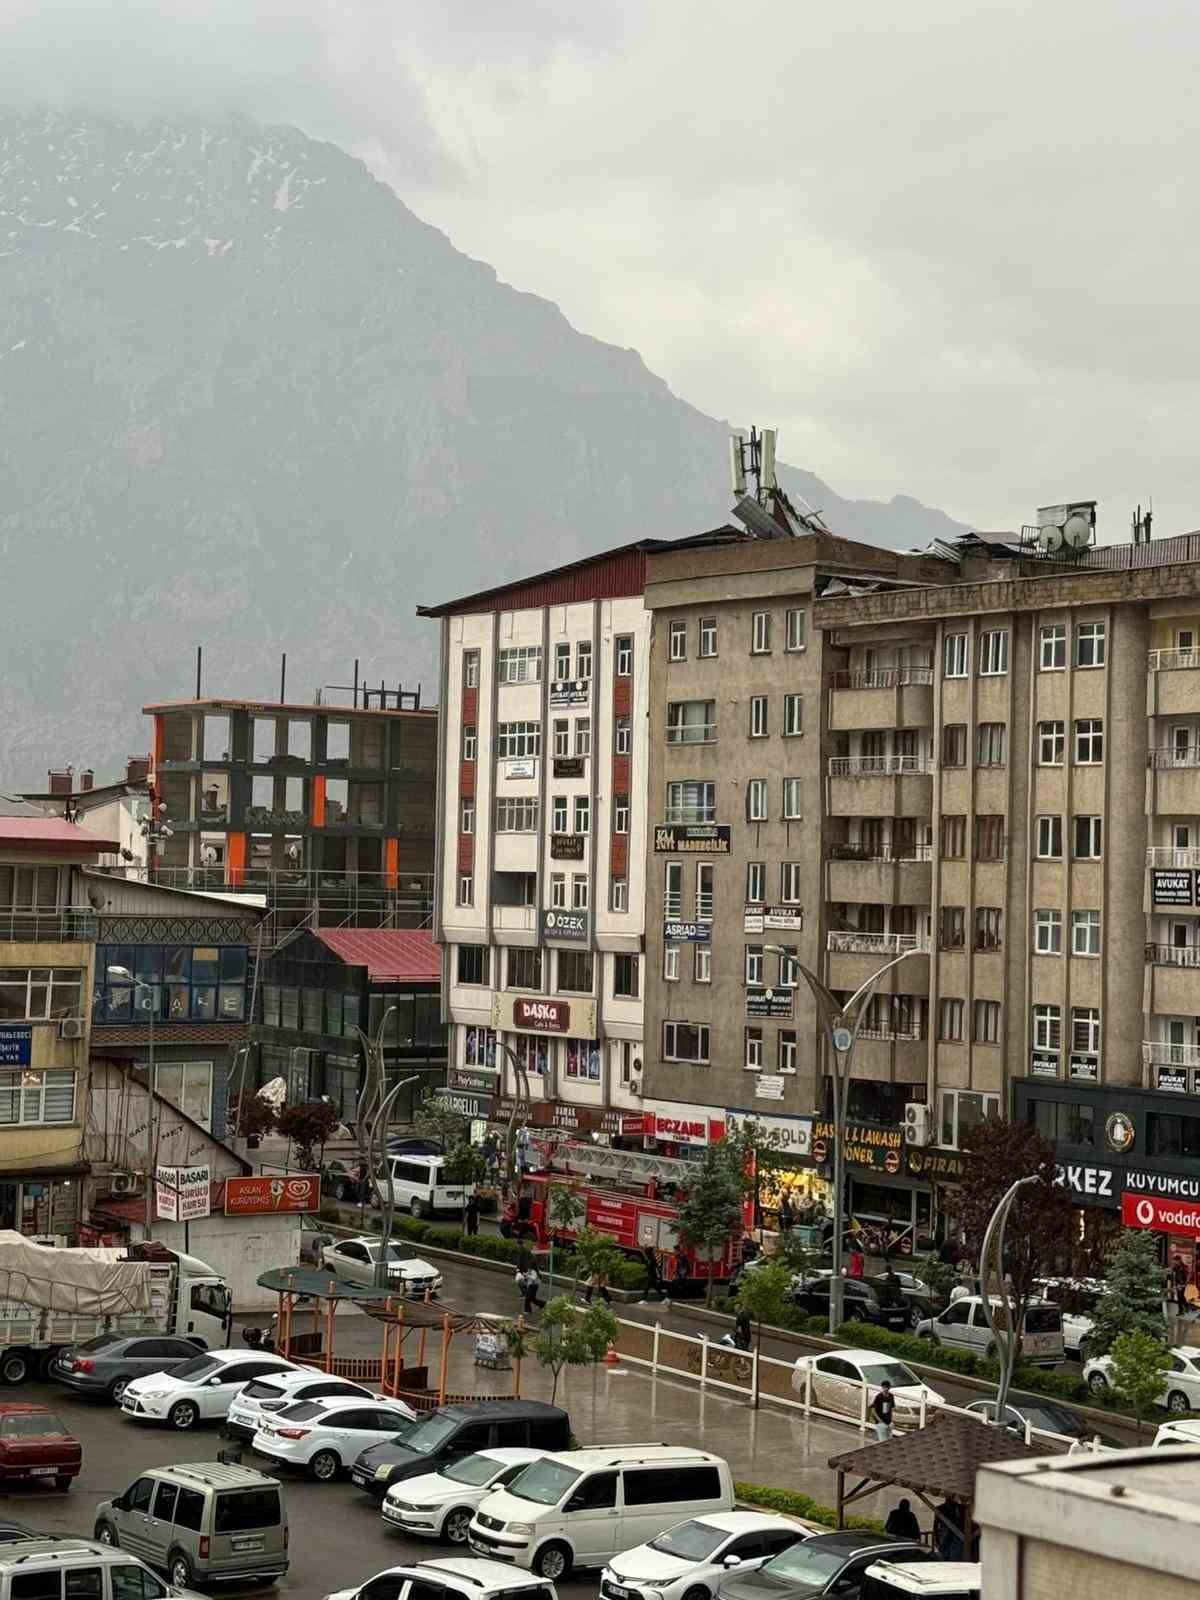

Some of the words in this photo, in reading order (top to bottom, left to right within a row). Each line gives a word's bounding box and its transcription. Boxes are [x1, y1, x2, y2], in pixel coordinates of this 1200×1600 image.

[1157, 879, 1189, 889] AVUKAT
[656, 1117, 705, 1137] ECZANE
[860, 1127, 902, 1148] LAWASH
